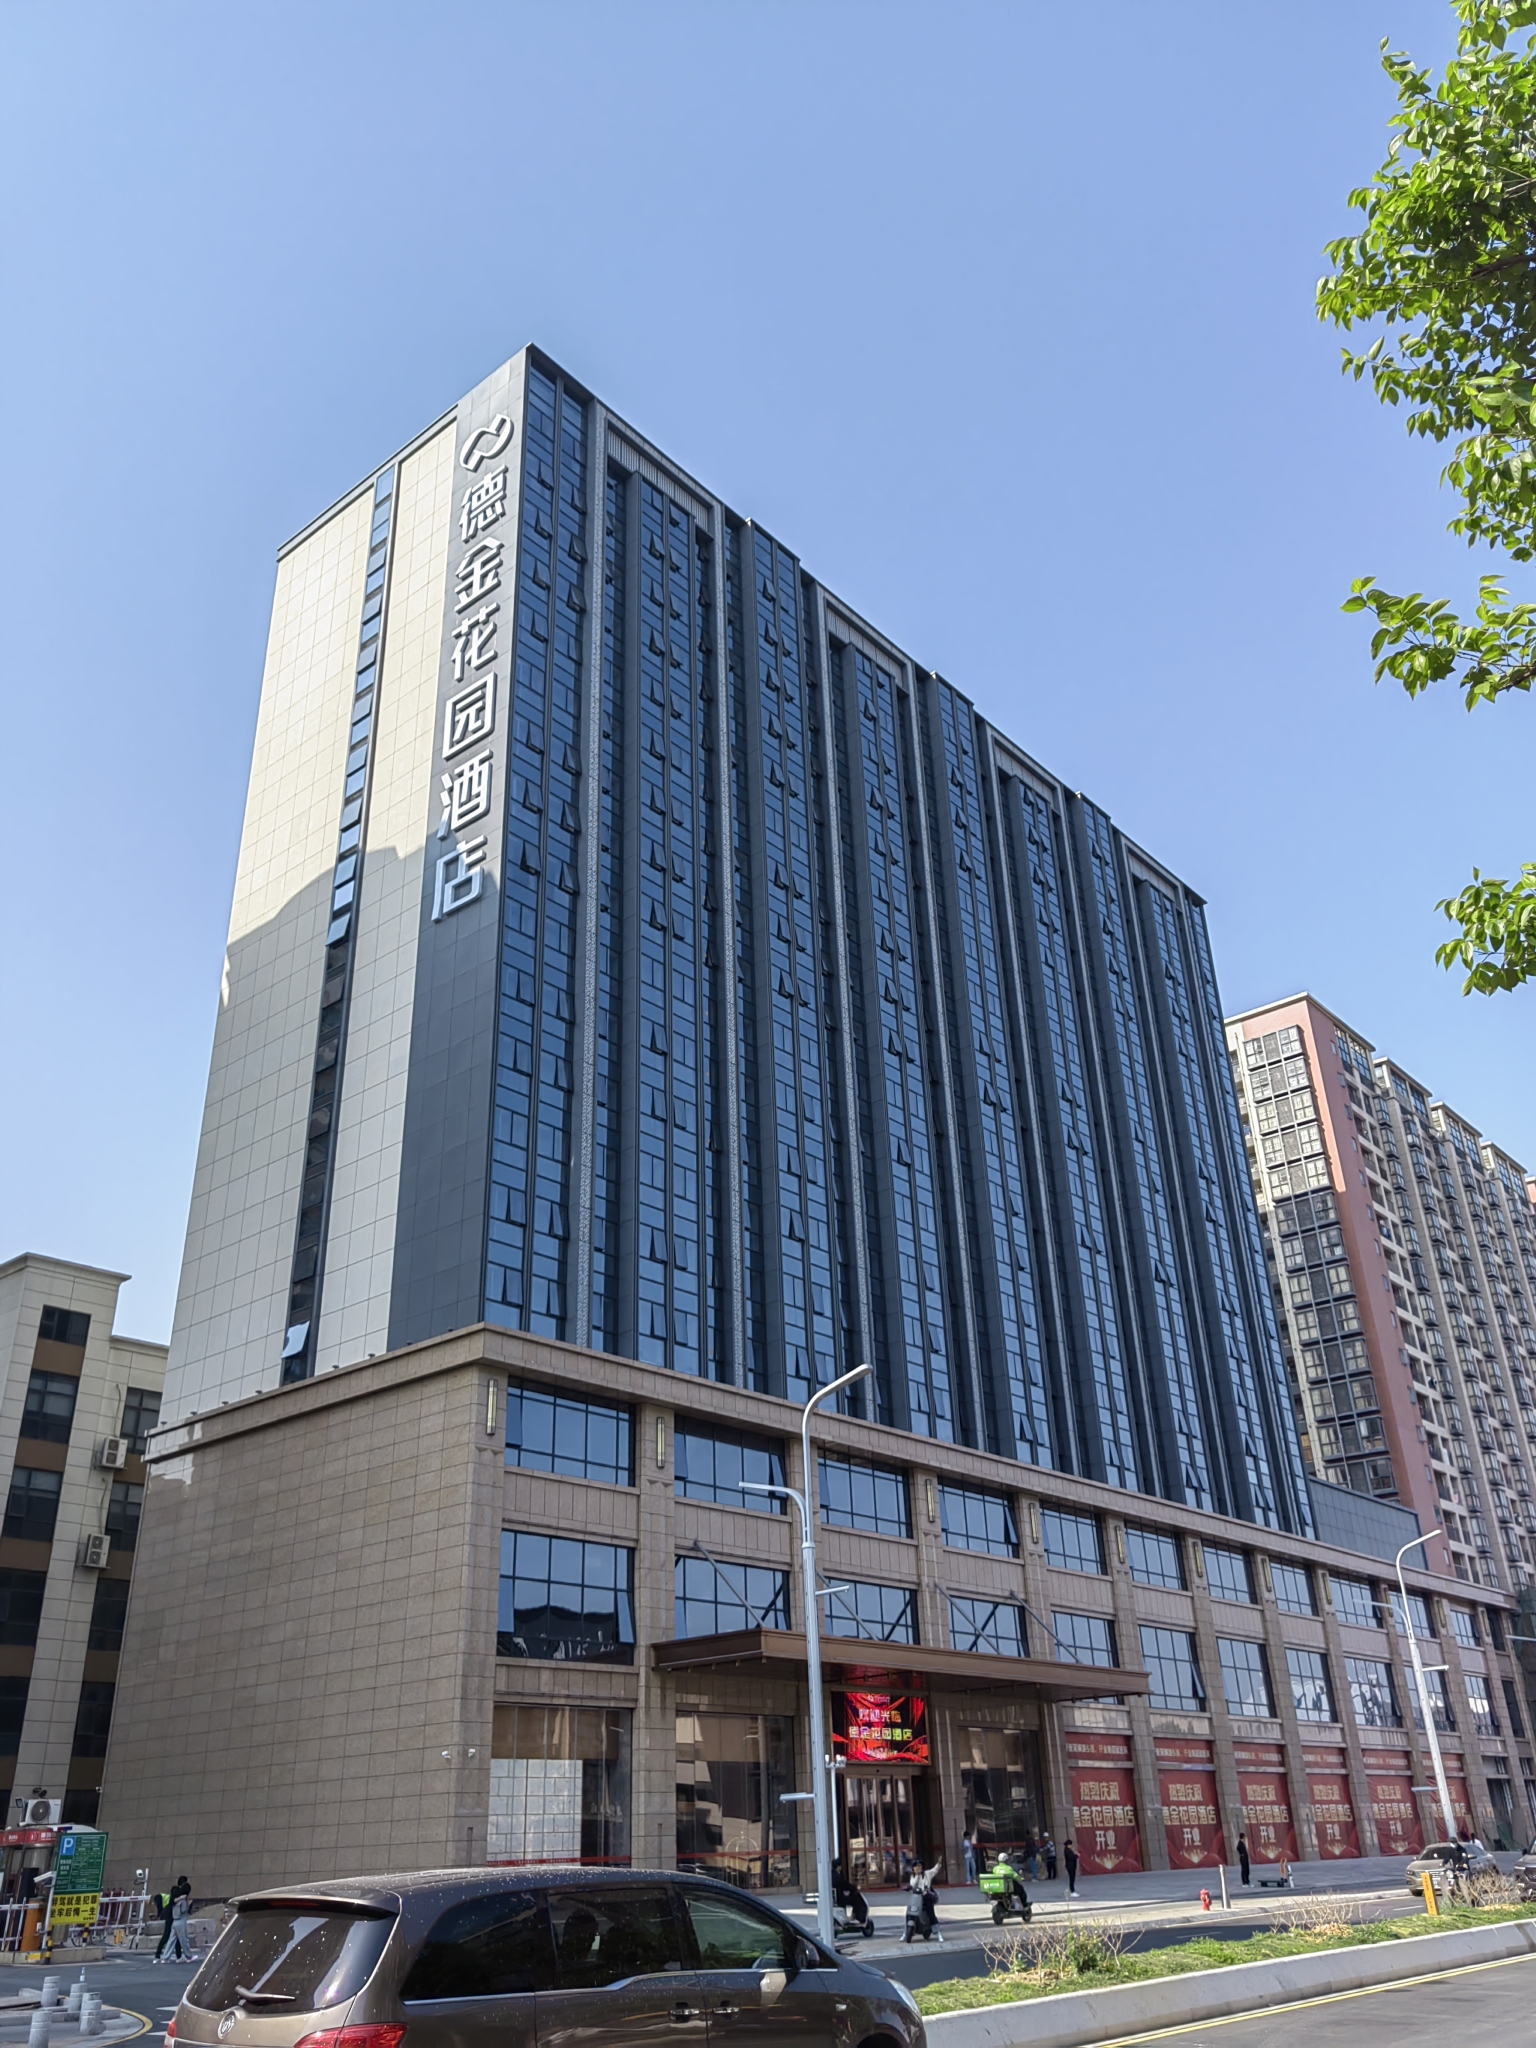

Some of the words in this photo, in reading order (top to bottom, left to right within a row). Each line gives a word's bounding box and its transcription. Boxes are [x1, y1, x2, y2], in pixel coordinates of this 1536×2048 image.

[430, 462, 509, 922] 德金花园酒店
[859, 1709, 901, 1722] 欢迎光临
[849, 1726, 912, 1740] 德金花园酒店
[1080, 1781, 1120, 1801] 热烈庆祝
[1168, 1784, 1203, 1801] 热烈庆祝
[62, 1837, 74, 1854] P
[1095, 1830, 1117, 1851] 开业
